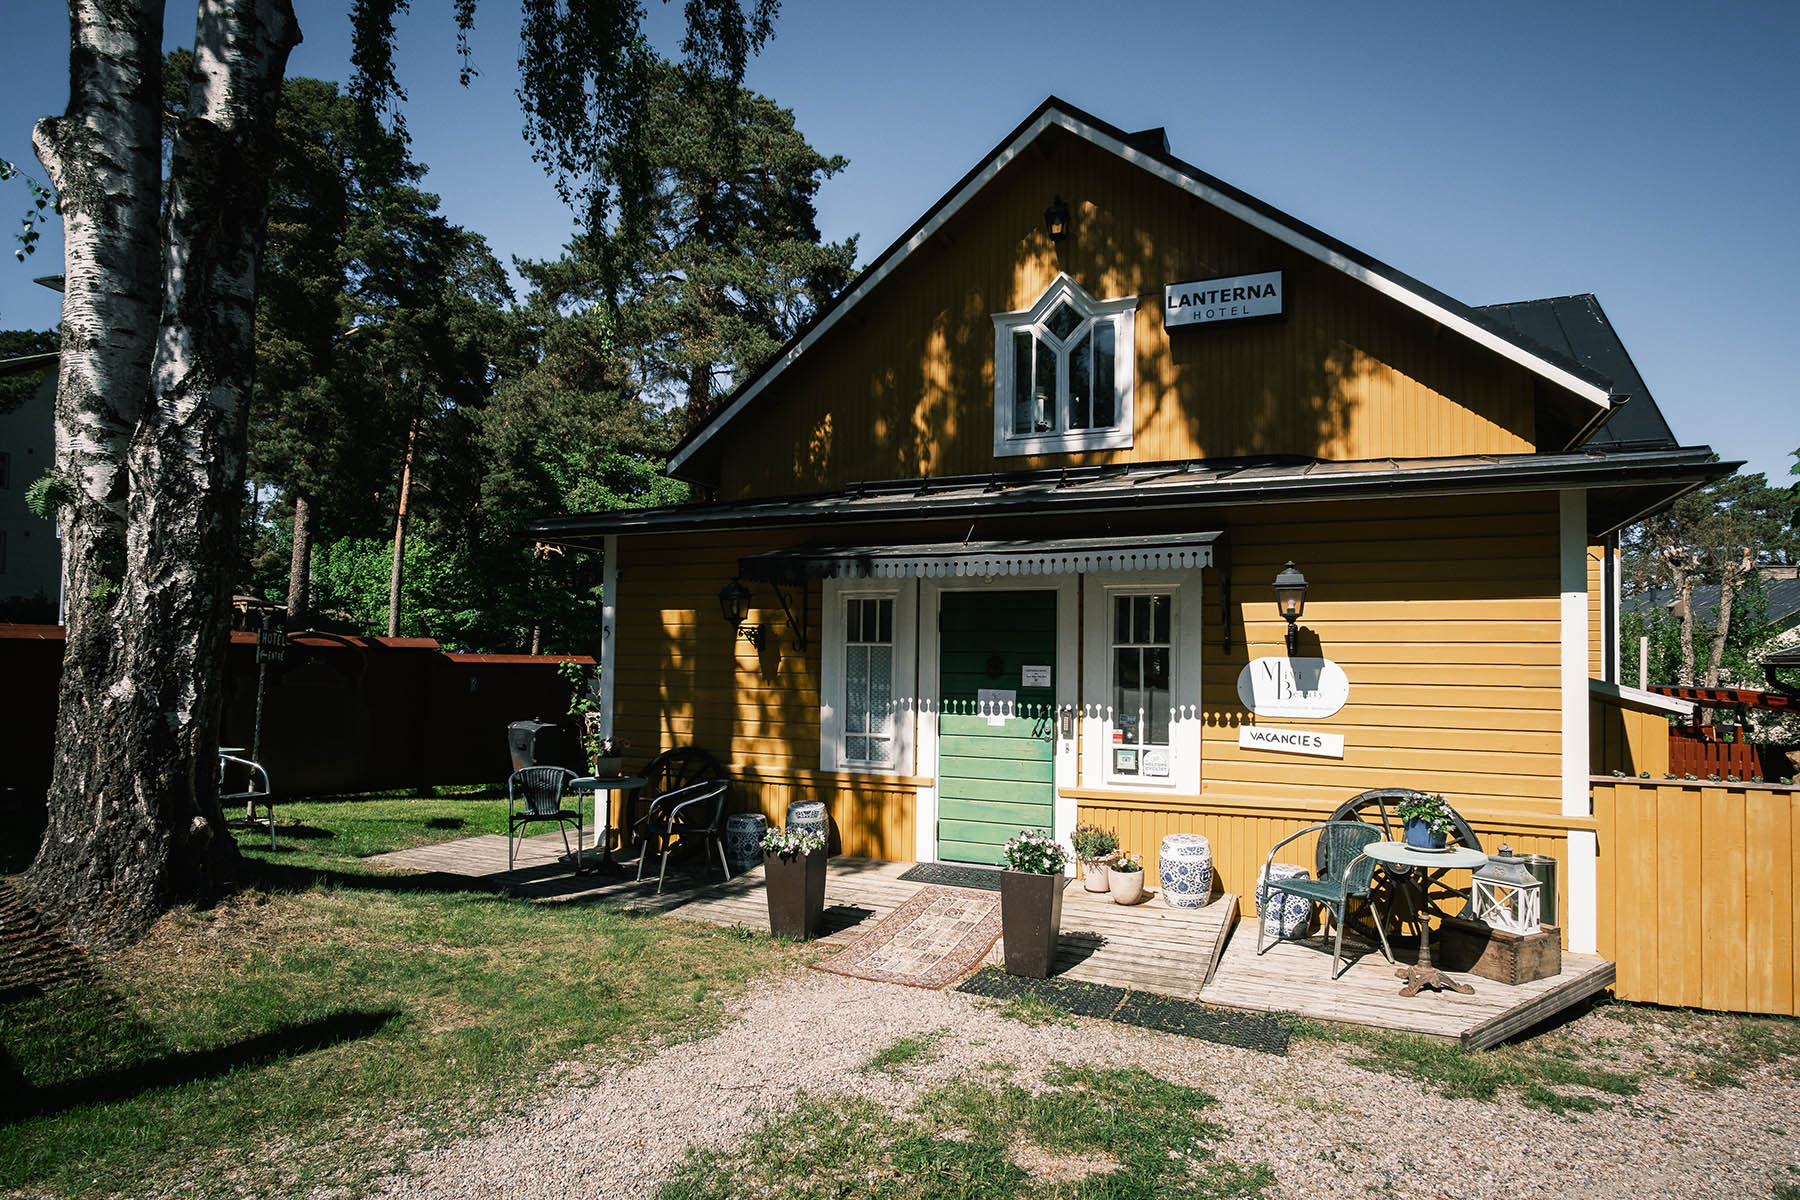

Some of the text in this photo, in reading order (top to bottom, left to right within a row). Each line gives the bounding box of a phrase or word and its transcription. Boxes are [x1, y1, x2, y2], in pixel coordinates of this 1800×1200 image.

[1167, 283, 1277, 309] LANTERNA
[1193, 305, 1250, 320] HOTEL
[262, 631, 286, 647] HOTEL
[603, 625, 611, 640] 5
[1250, 730, 1322, 748] VACANCIES
